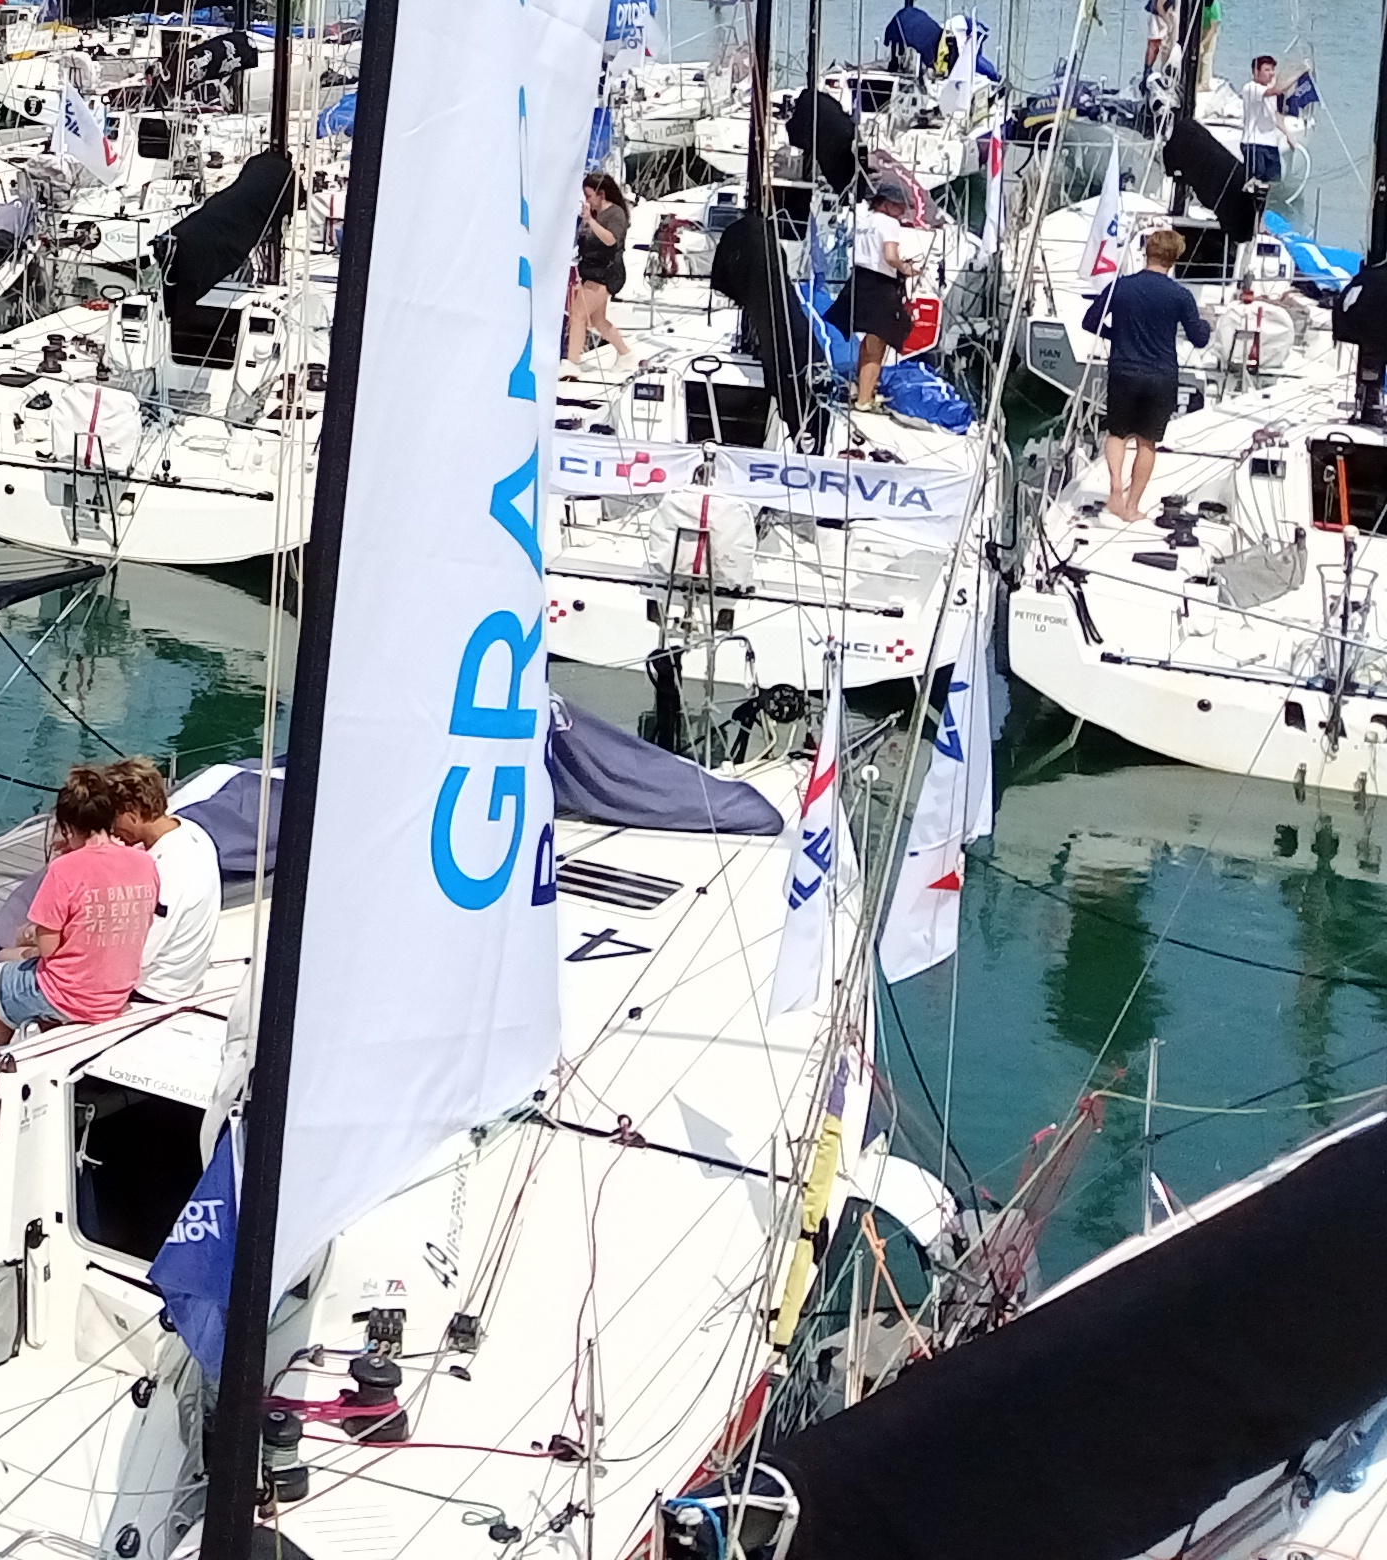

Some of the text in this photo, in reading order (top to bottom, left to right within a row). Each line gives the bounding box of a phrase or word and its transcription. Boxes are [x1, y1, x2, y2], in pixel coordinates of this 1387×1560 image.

[1014, 609, 1043, 623] PETITE
[84, 885, 154, 904] ST BARTH
[153, 1080, 192, 1099] GRAND
